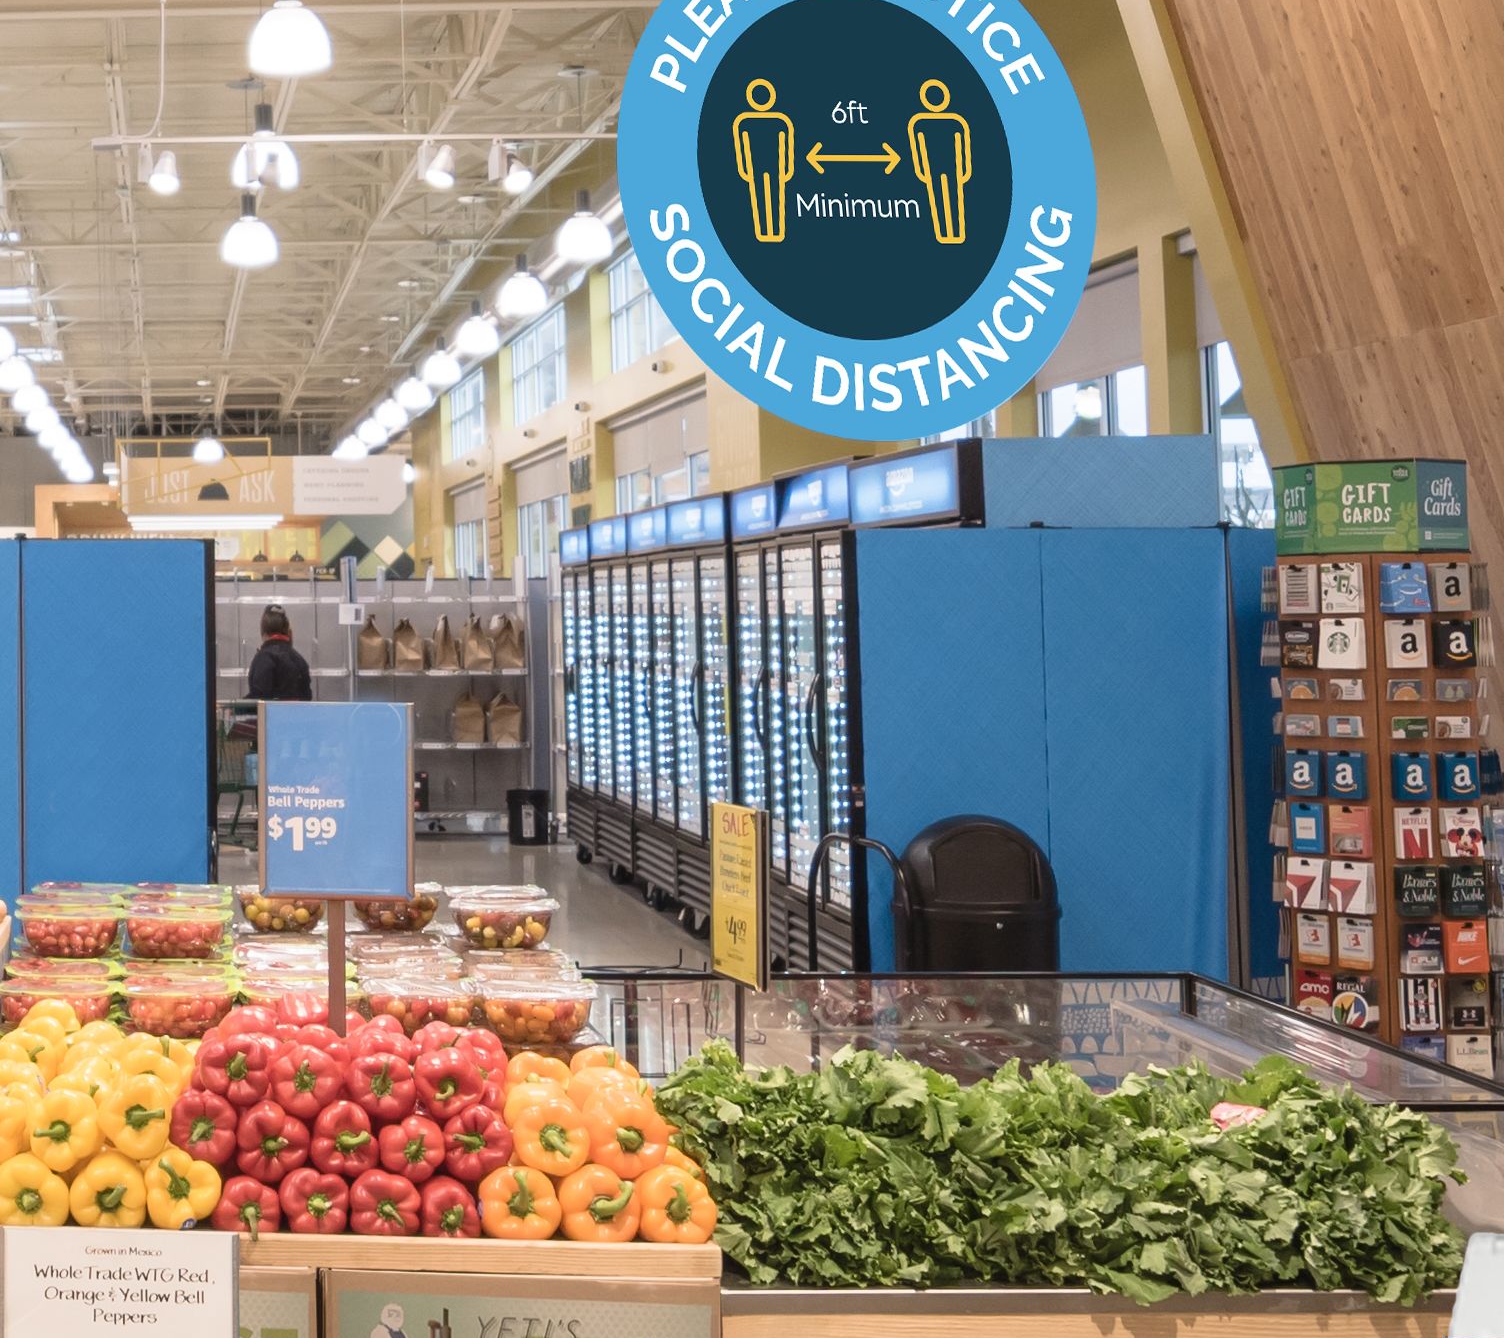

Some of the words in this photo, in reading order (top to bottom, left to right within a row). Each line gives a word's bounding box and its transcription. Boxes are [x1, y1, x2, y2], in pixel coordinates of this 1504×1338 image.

[832, 100, 868, 124] 6ft
[797, 193, 920, 218] Minimum
[651, 204, 792, 391] SOCIAL
[813, 205, 1072, 411] DISTANCING
[1342, 482, 1391, 505] GIFT
[1430, 477, 1454, 500] Gift
[1342, 506, 1392, 524] CARDS
[1424, 497, 1461, 517] Cards
[268, 786, 295, 794] Whole
[297, 786, 320, 794] Trade
[268, 796, 291, 807] Bell
[295, 796, 345, 810] Peppers
[34, 1264, 82, 1280] Whole
[83, 1266, 132, 1281] Trade
[44, 1286, 105, 1305] Orange
[120, 1288, 171, 1304] Yellow
[175, 1290, 205, 1305] Bell
[93, 1308, 157, 1325] Peppers
